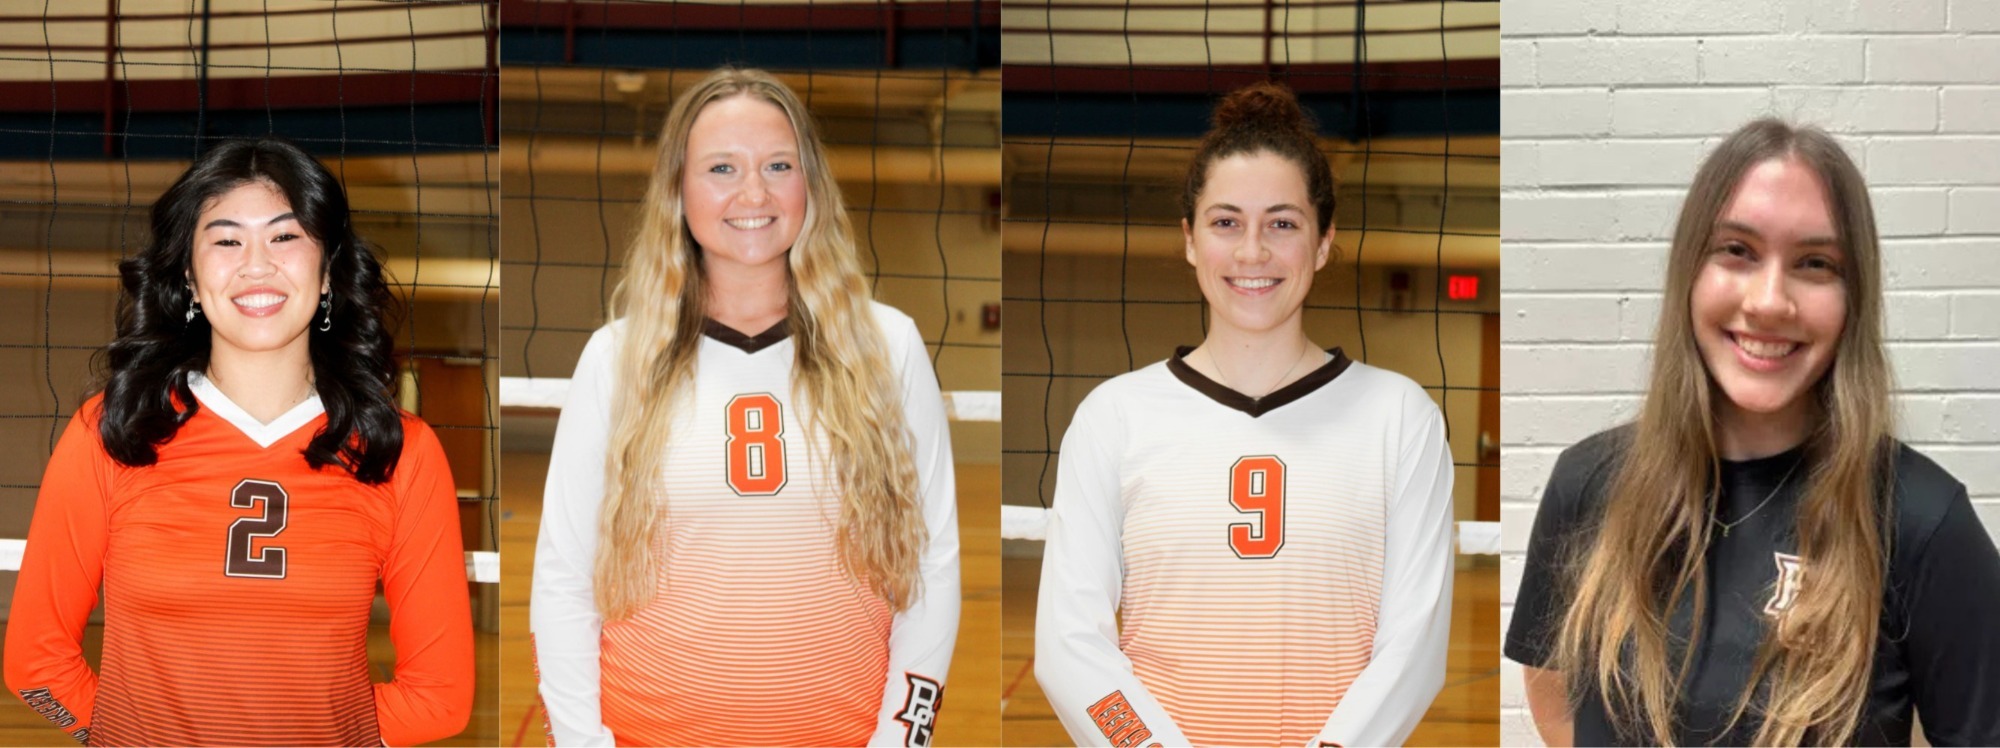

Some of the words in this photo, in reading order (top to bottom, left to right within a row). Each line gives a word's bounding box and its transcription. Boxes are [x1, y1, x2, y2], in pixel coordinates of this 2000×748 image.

[725, 392, 788, 497] 8
[224, 478, 288, 578] 2
[1228, 454, 1287, 560] 9
[1086, 690, 1152, 747] GREEN
